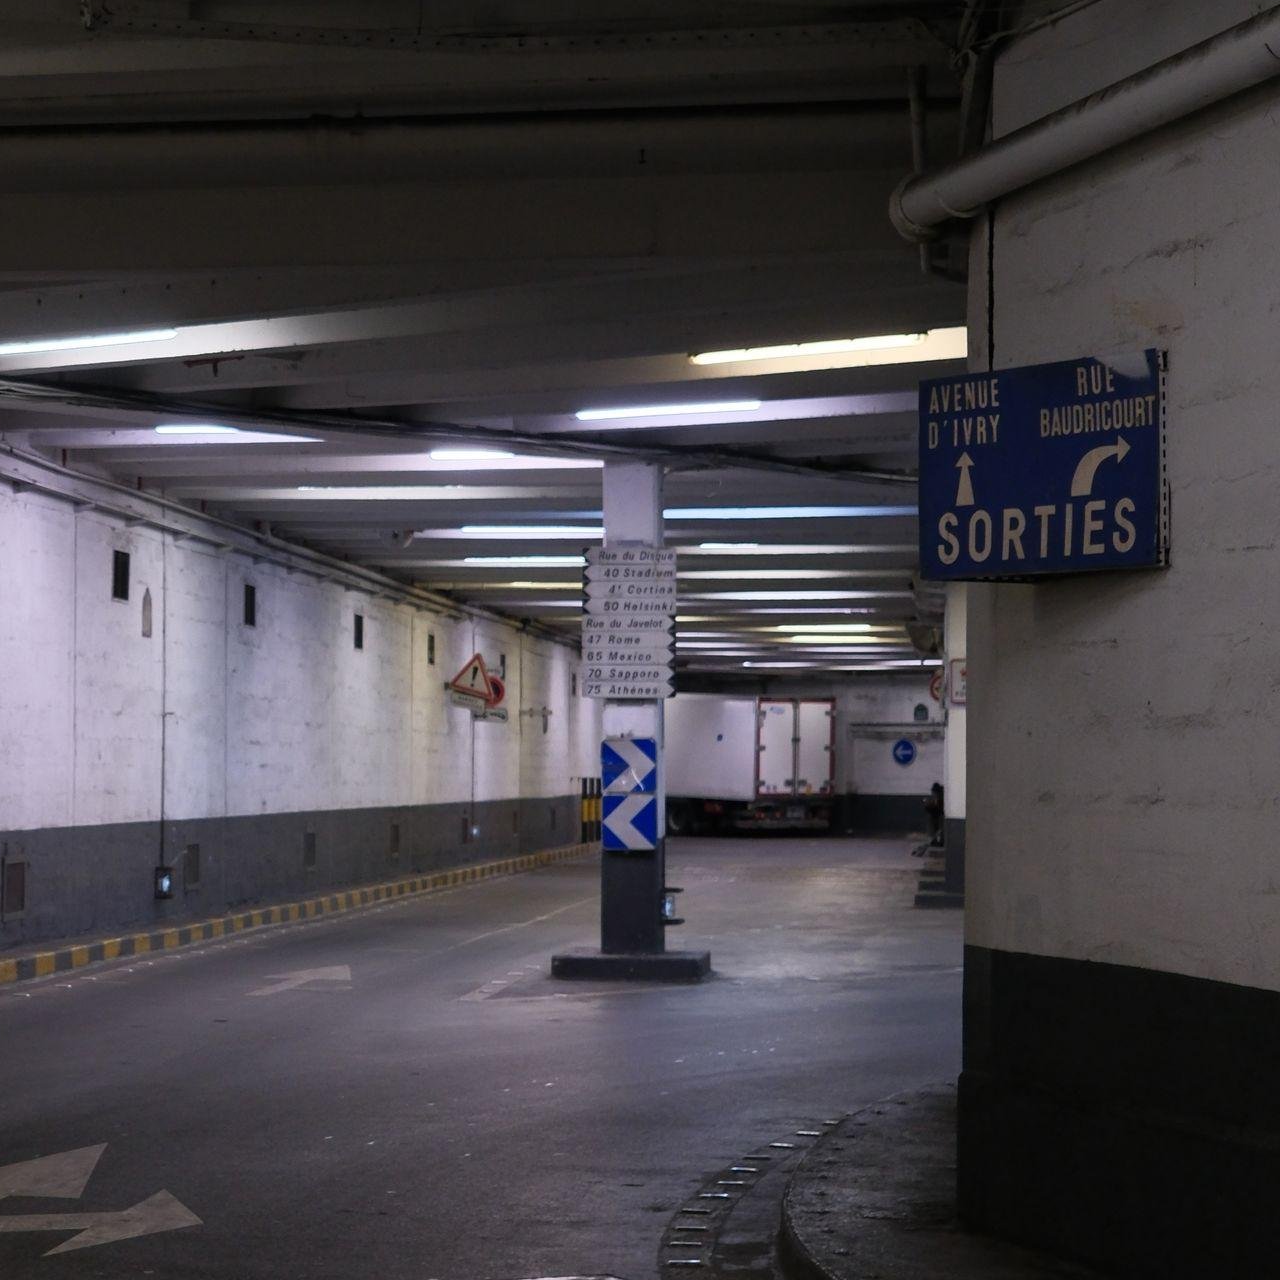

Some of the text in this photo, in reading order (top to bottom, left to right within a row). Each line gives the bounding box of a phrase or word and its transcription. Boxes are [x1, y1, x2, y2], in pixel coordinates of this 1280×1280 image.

[1076, 365, 1115, 396] RUE
[928, 378, 1000, 414] AVENUE
[1039, 395, 1156, 438] BAUDRICOURT
[928, 414, 1001, 450] D'IVRY
[937, 497, 1137, 566] SORTIES
[598, 551, 674, 562] Rue du Disque
[623, 568, 673, 577] Stadium
[627, 585, 673, 594] Cortina
[623, 601, 673, 611] Helsinki
[586, 618, 663, 628] Rue du Javelot
[587, 635, 641, 644] 47 Rome
[608, 651, 652, 661] Mexico
[588, 668, 659, 680] 70 Sapporo
[587, 685, 602, 694] 75
